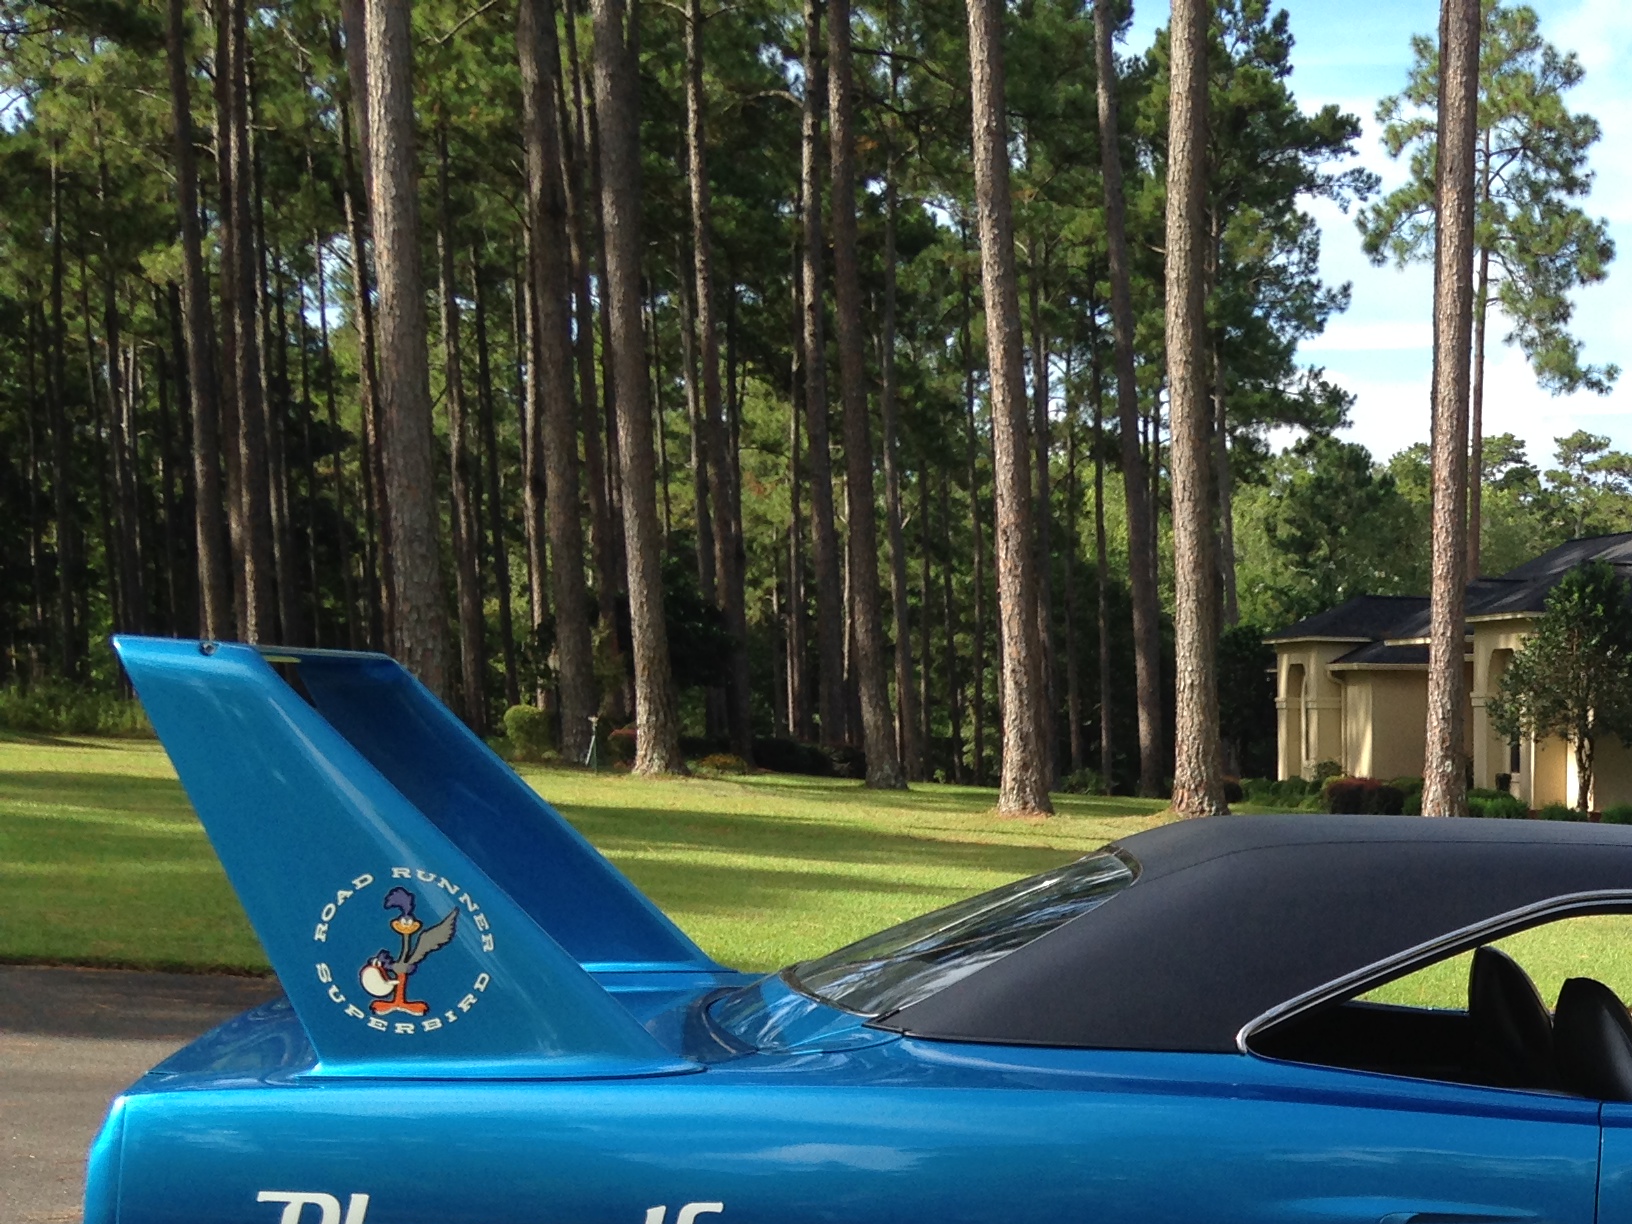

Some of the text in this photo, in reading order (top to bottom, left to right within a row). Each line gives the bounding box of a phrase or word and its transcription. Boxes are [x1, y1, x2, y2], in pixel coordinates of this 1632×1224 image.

[313, 867, 494, 952] ROAD RUNNER
[315, 962, 491, 1034] SUPERBIRD
